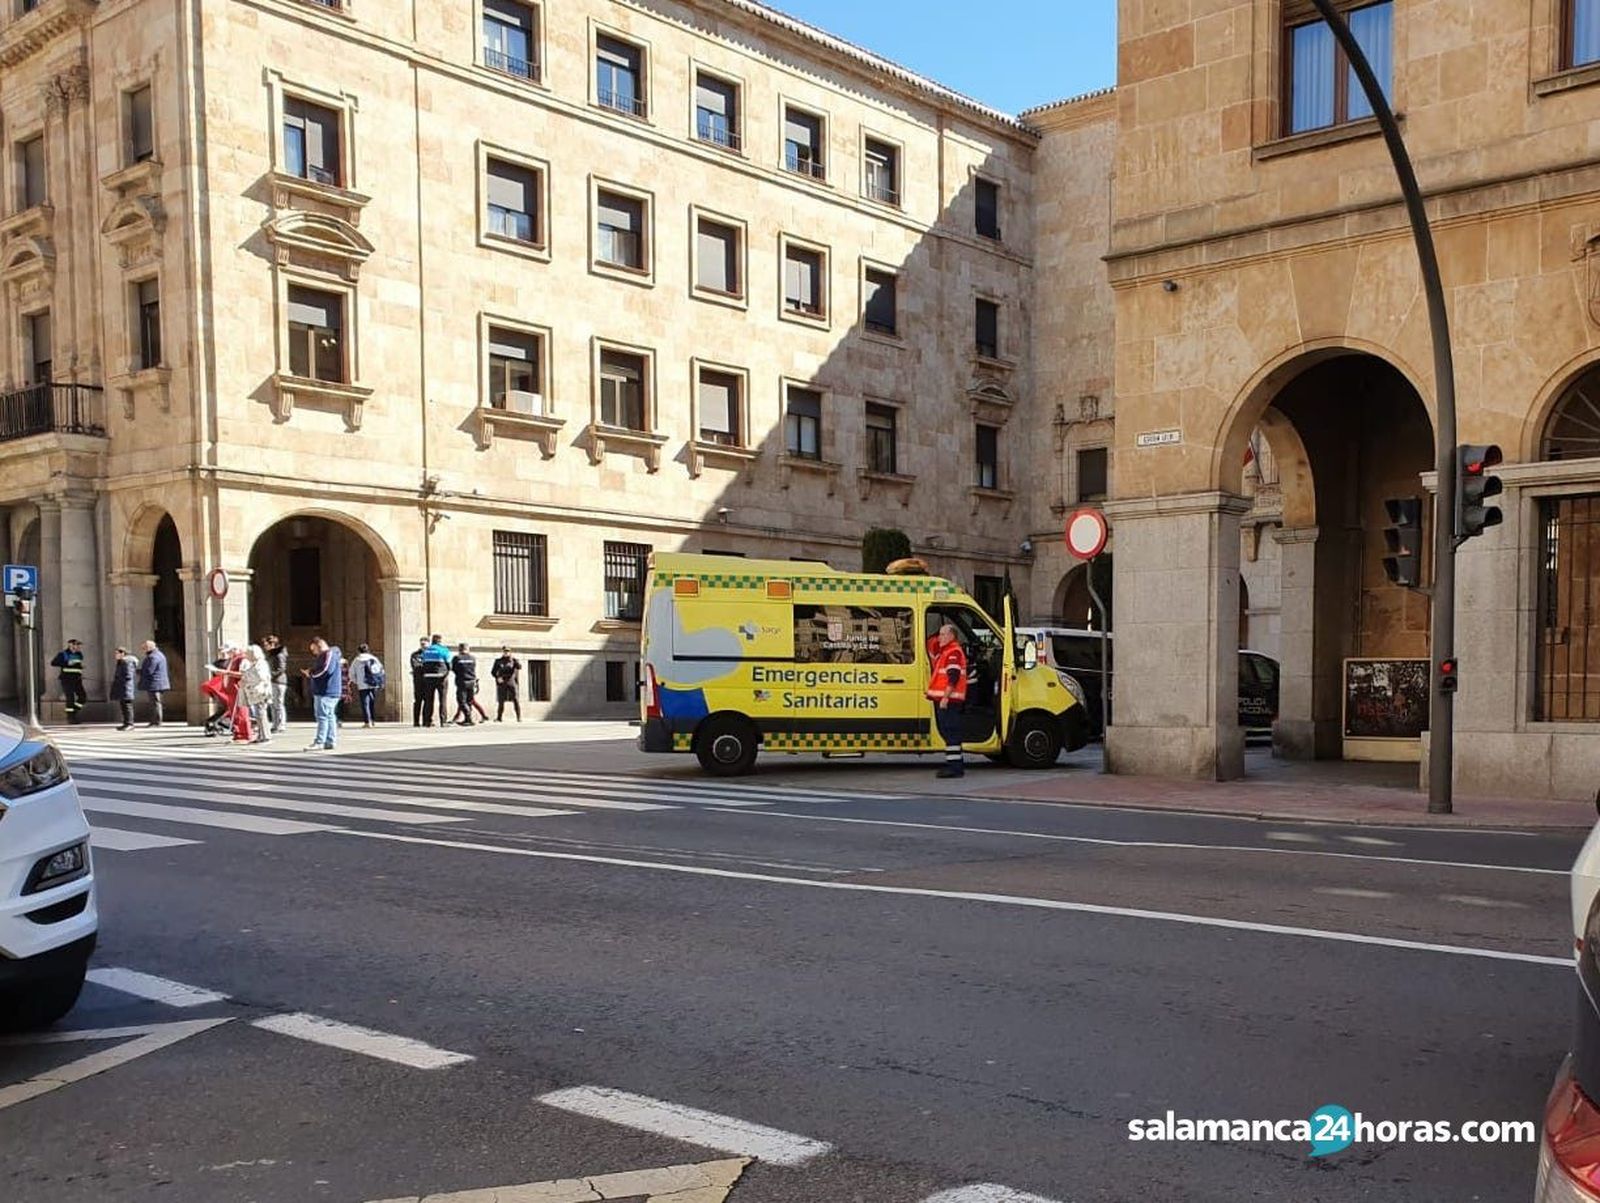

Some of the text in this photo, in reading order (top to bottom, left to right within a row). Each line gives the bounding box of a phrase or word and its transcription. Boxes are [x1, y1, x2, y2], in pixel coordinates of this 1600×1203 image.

[10, 568, 30, 590] P
[844, 634, 867, 642] Junta
[752, 666, 879, 687] Emergencias
[783, 692, 878, 709] Sanitarias
